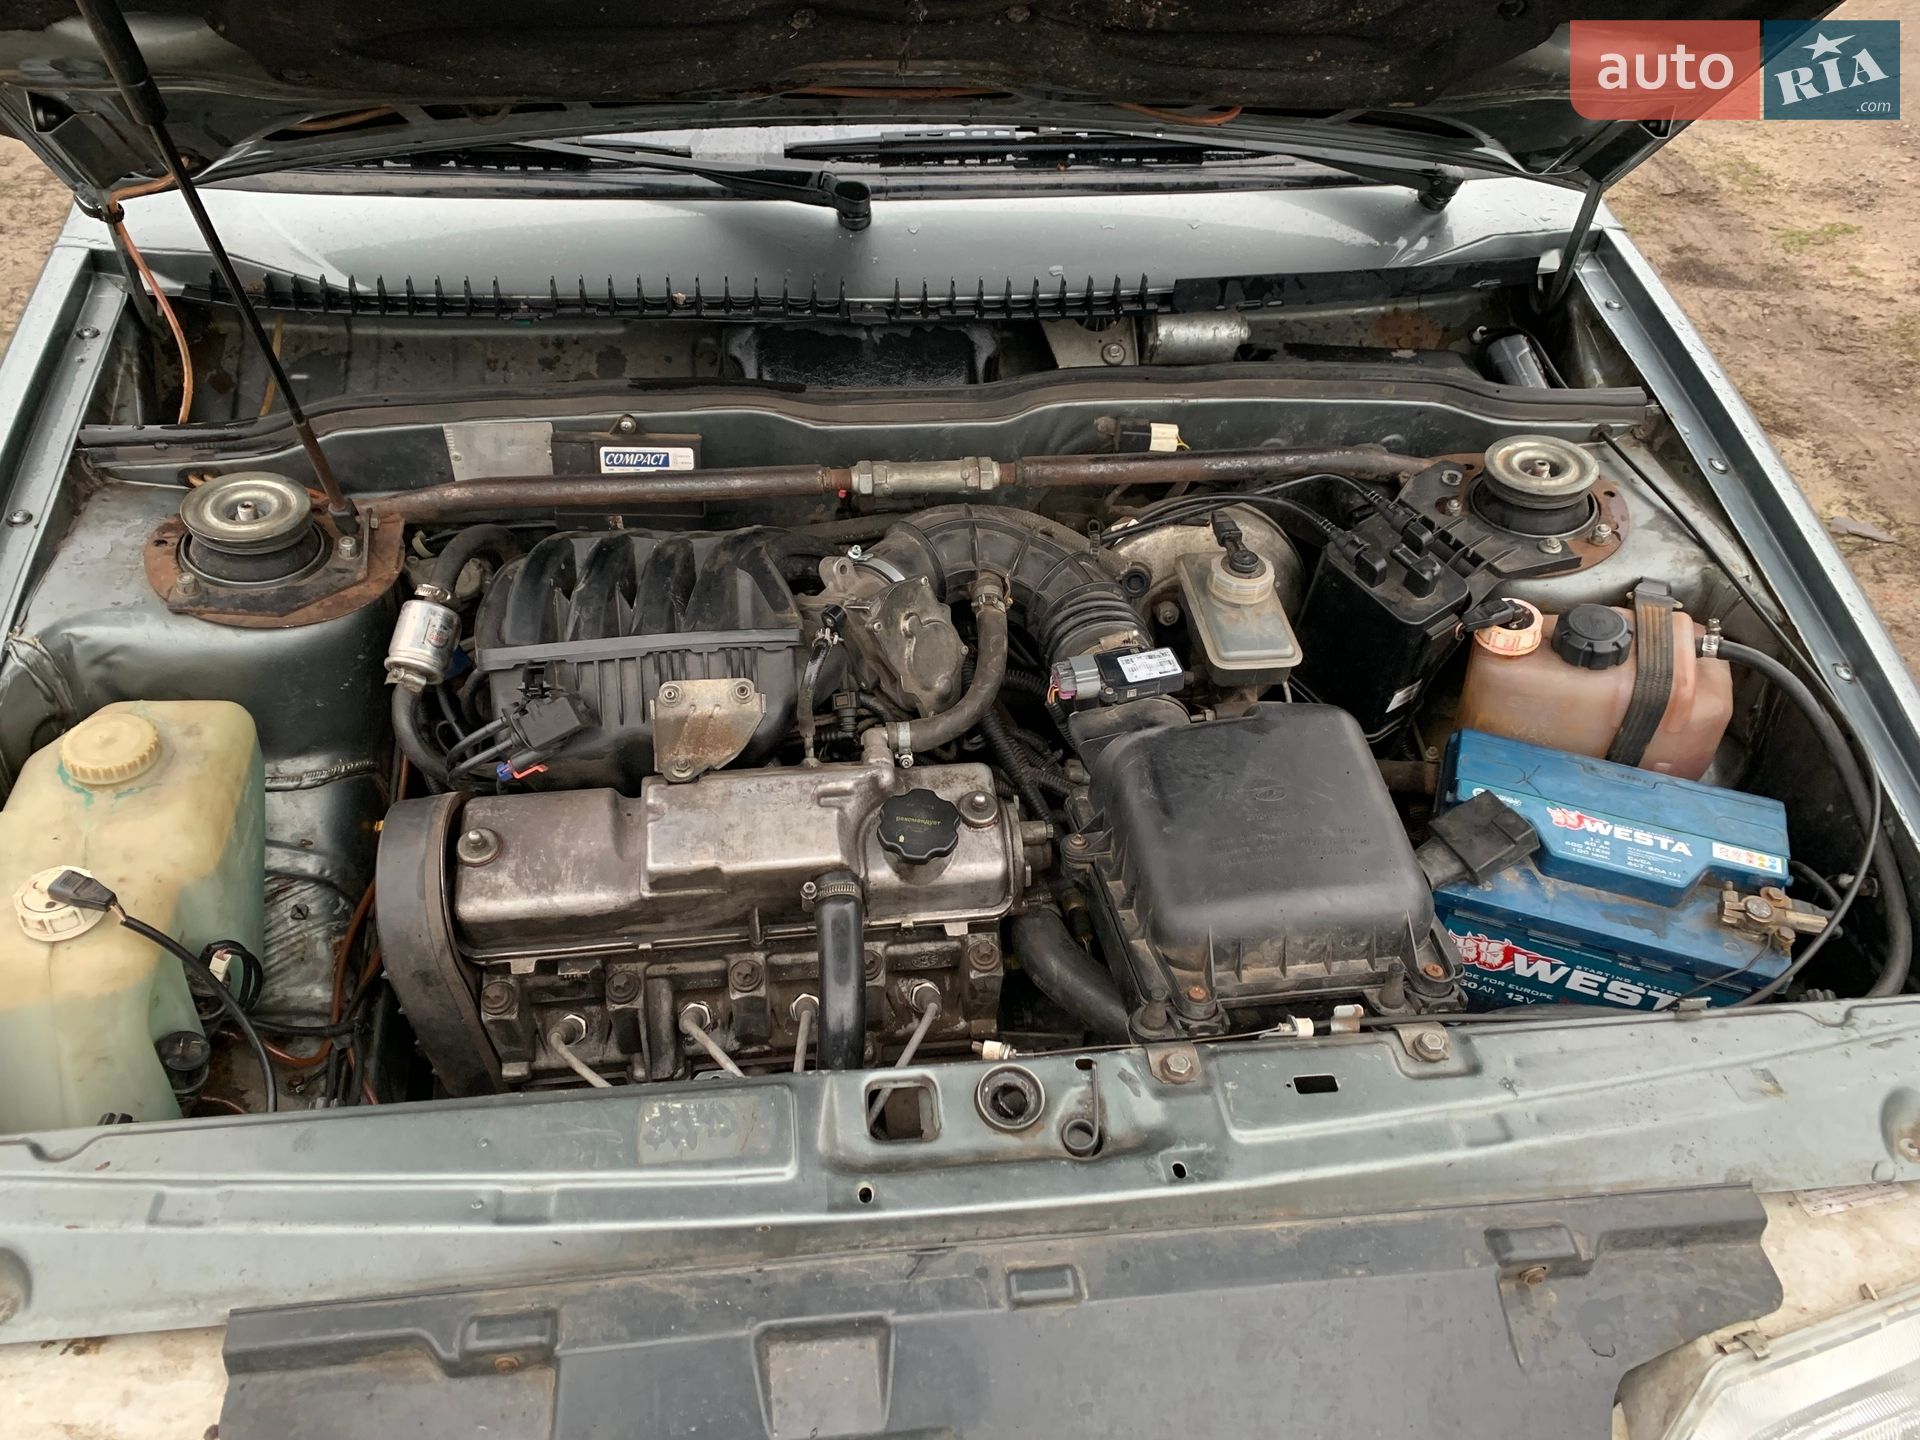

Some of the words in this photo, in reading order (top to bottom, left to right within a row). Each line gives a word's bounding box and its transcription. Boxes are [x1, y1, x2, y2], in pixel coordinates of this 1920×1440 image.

[605, 453, 666, 465] COMPACT
[1583, 819, 1693, 857] WESTA
[1482, 976, 1506, 987] FOR
[1508, 983, 1554, 1000] EUROPE
[1513, 953, 1680, 1012] WEST
[1575, 964, 1632, 984] STARTING
[1636, 981, 1683, 997] BATTER
